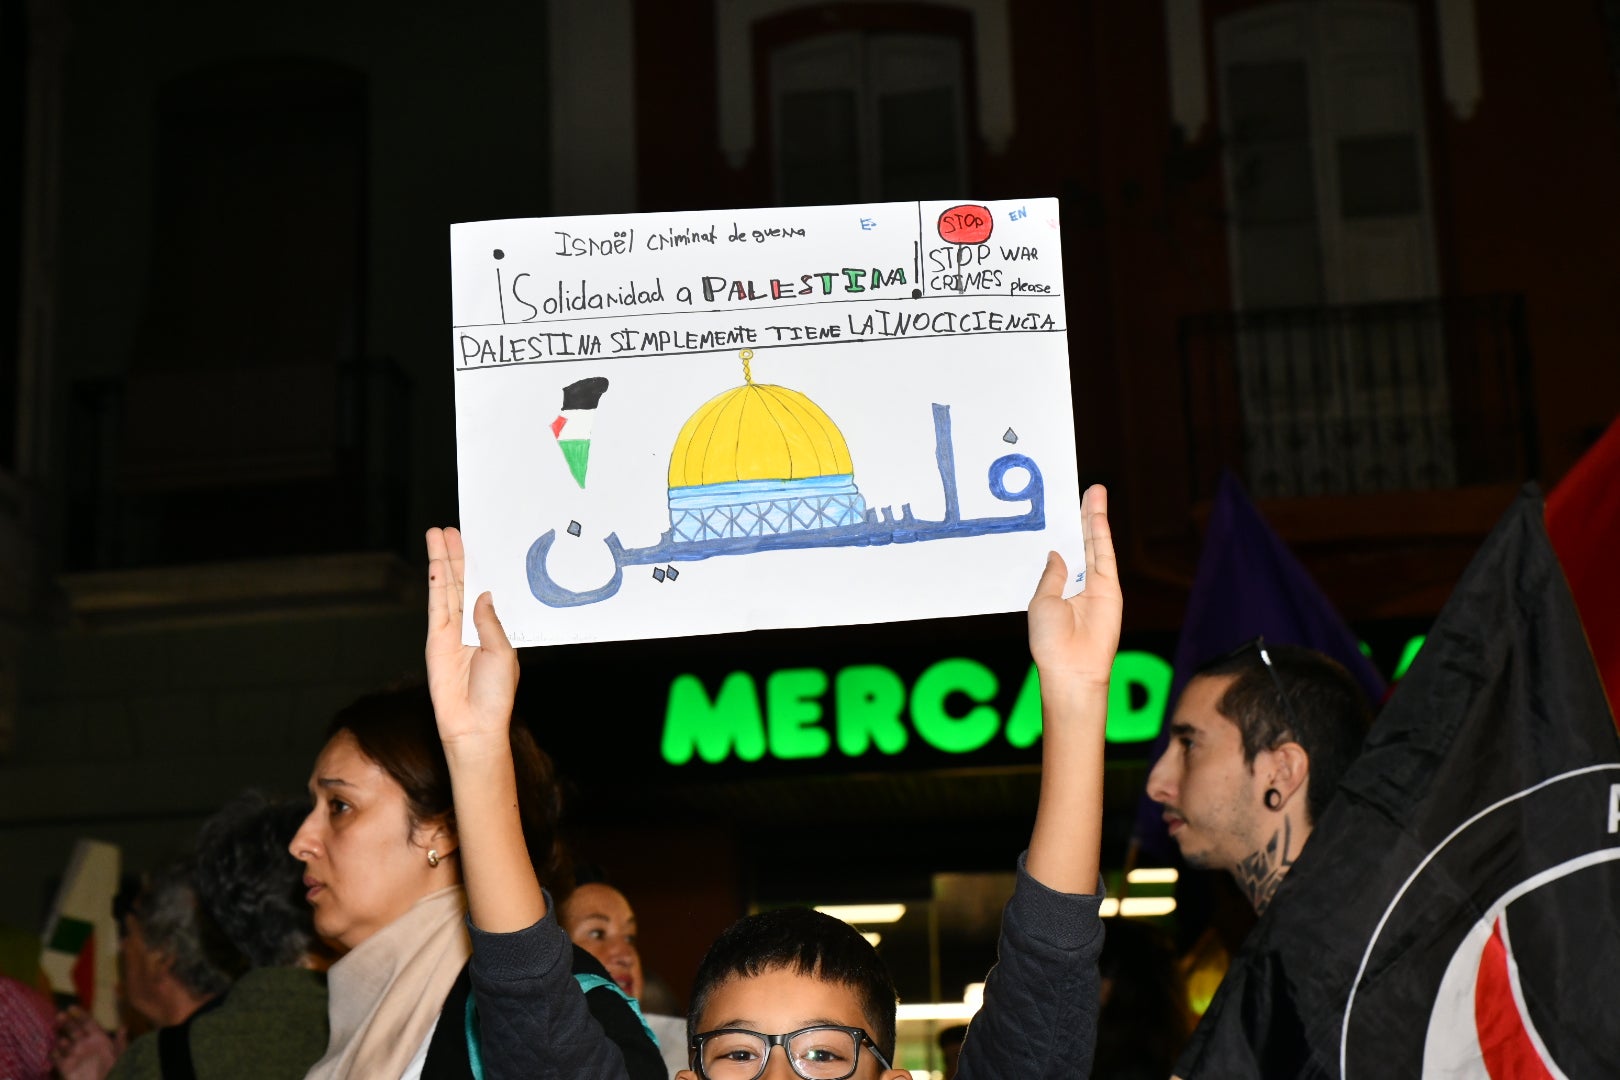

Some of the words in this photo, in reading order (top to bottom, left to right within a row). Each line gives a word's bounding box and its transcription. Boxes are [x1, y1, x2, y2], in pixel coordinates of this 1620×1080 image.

[1008, 205, 1028, 222] EN
[554, 229, 634, 257] Israël
[728, 222, 747, 242] de
[752, 227, 806, 243] guerra
[929, 244, 991, 273] STOP
[1000, 246, 1039, 262] WAR
[676, 286, 692, 305] a
[930, 269, 1003, 293] CRIMES
[1010, 277, 1051, 296] please
[459, 331, 602, 366] PALESTINA
[610, 325, 758, 353] SIMPLEMENTE
[765, 323, 842, 342] TIENE
